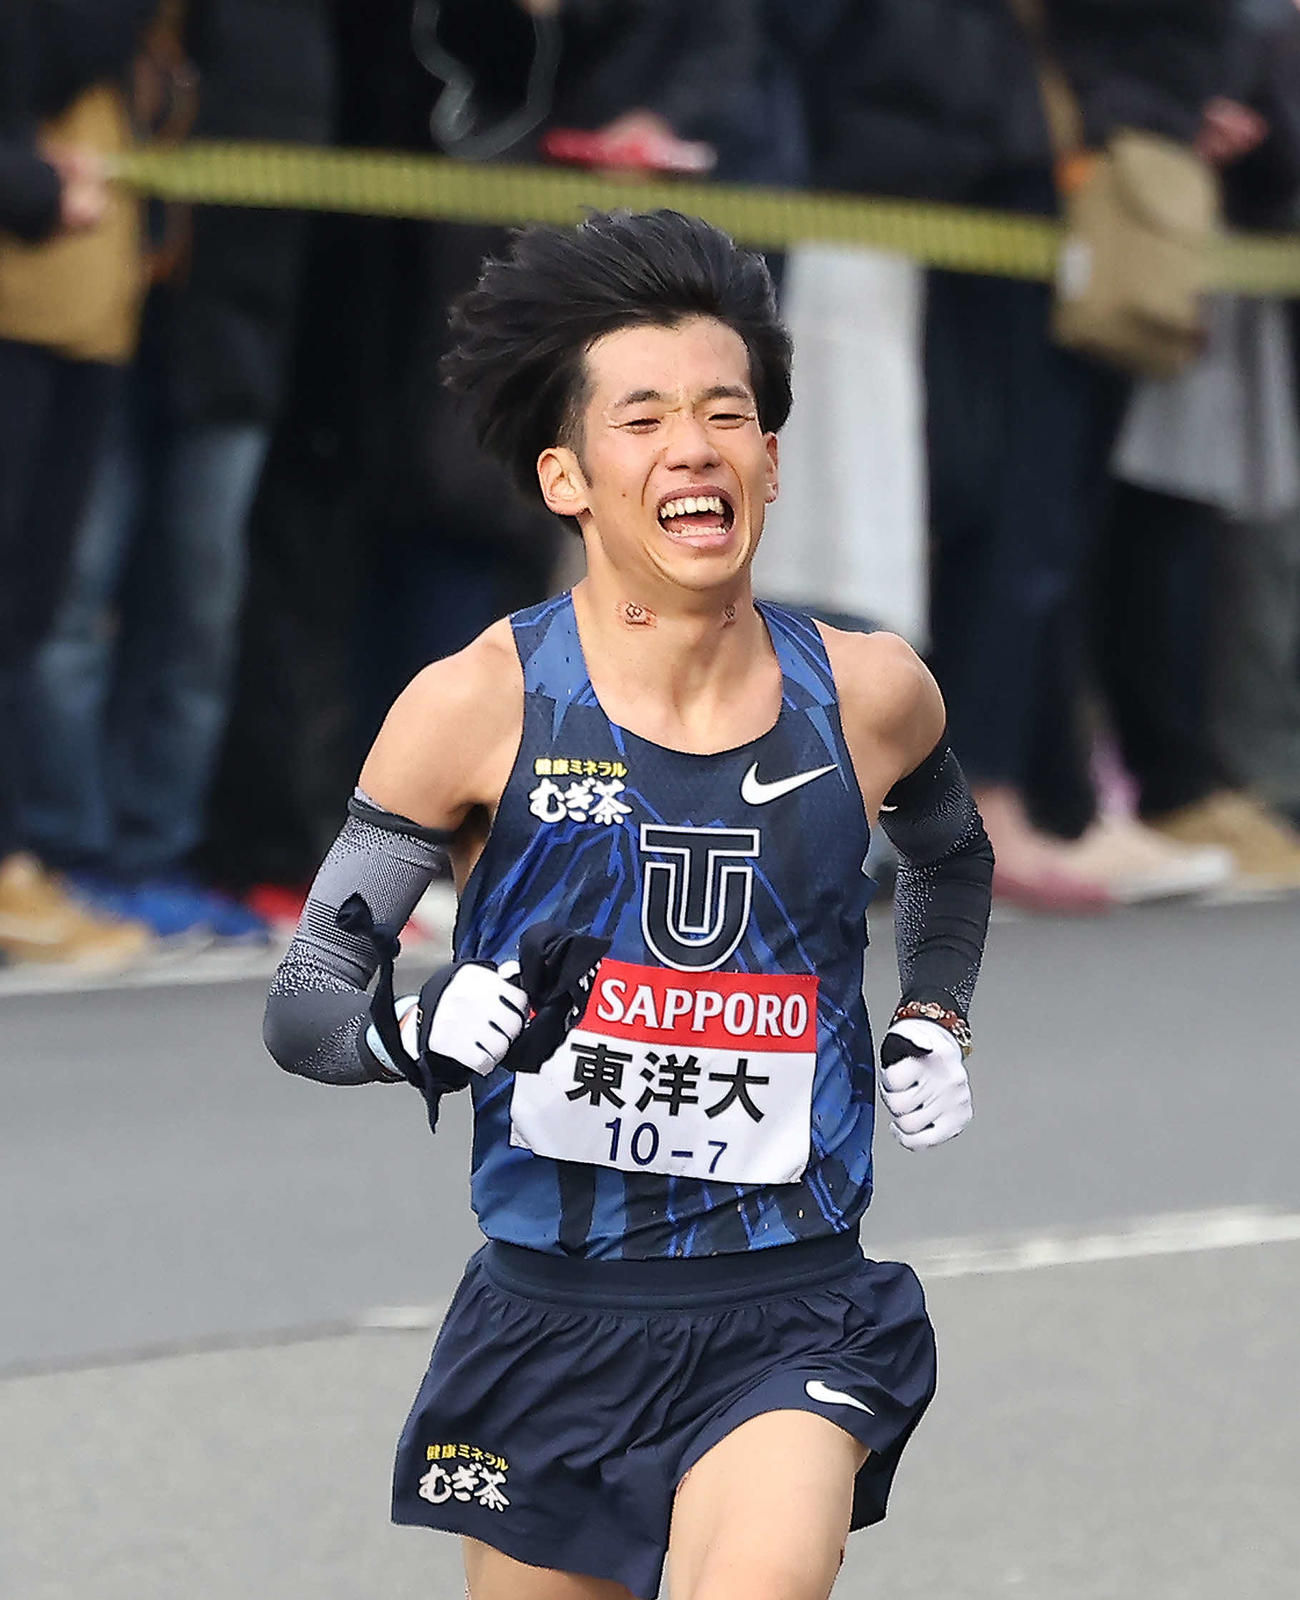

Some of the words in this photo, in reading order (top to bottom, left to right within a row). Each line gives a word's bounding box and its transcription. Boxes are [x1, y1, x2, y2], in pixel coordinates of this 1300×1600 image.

[535, 758, 628, 778] 健康ミネラル
[529, 777, 633, 825] むぎ茶
[597, 978, 808, 1038] SAPPORO
[565, 1043, 770, 1123] 東洋大
[426, 1444, 509, 1472] 健康ミネラル
[419, 1463, 510, 1512] むぎ茶
